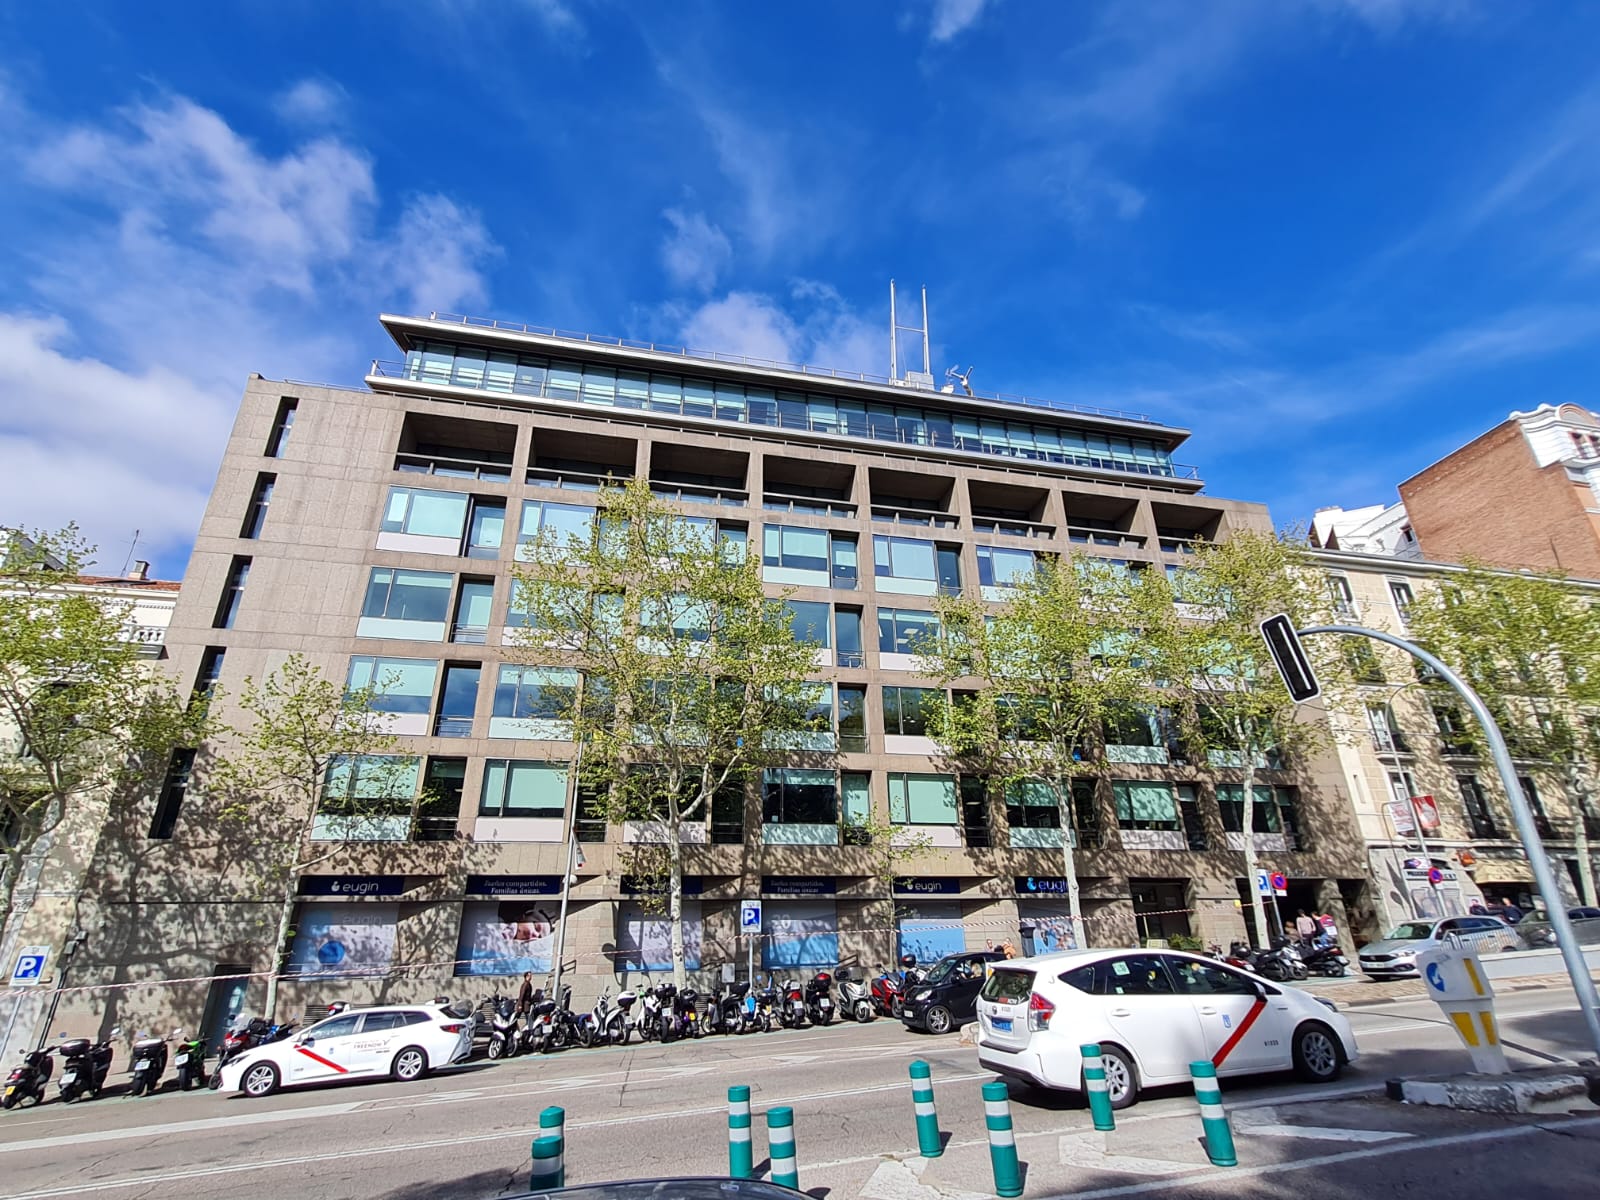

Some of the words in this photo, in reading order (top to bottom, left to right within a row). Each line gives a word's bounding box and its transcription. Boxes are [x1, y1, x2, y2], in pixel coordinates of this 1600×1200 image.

[342, 882, 379, 894] eugin
[914, 881, 942, 893] eugin
[1038, 879, 1069, 893] eugi
[16, 957, 37, 977] P
